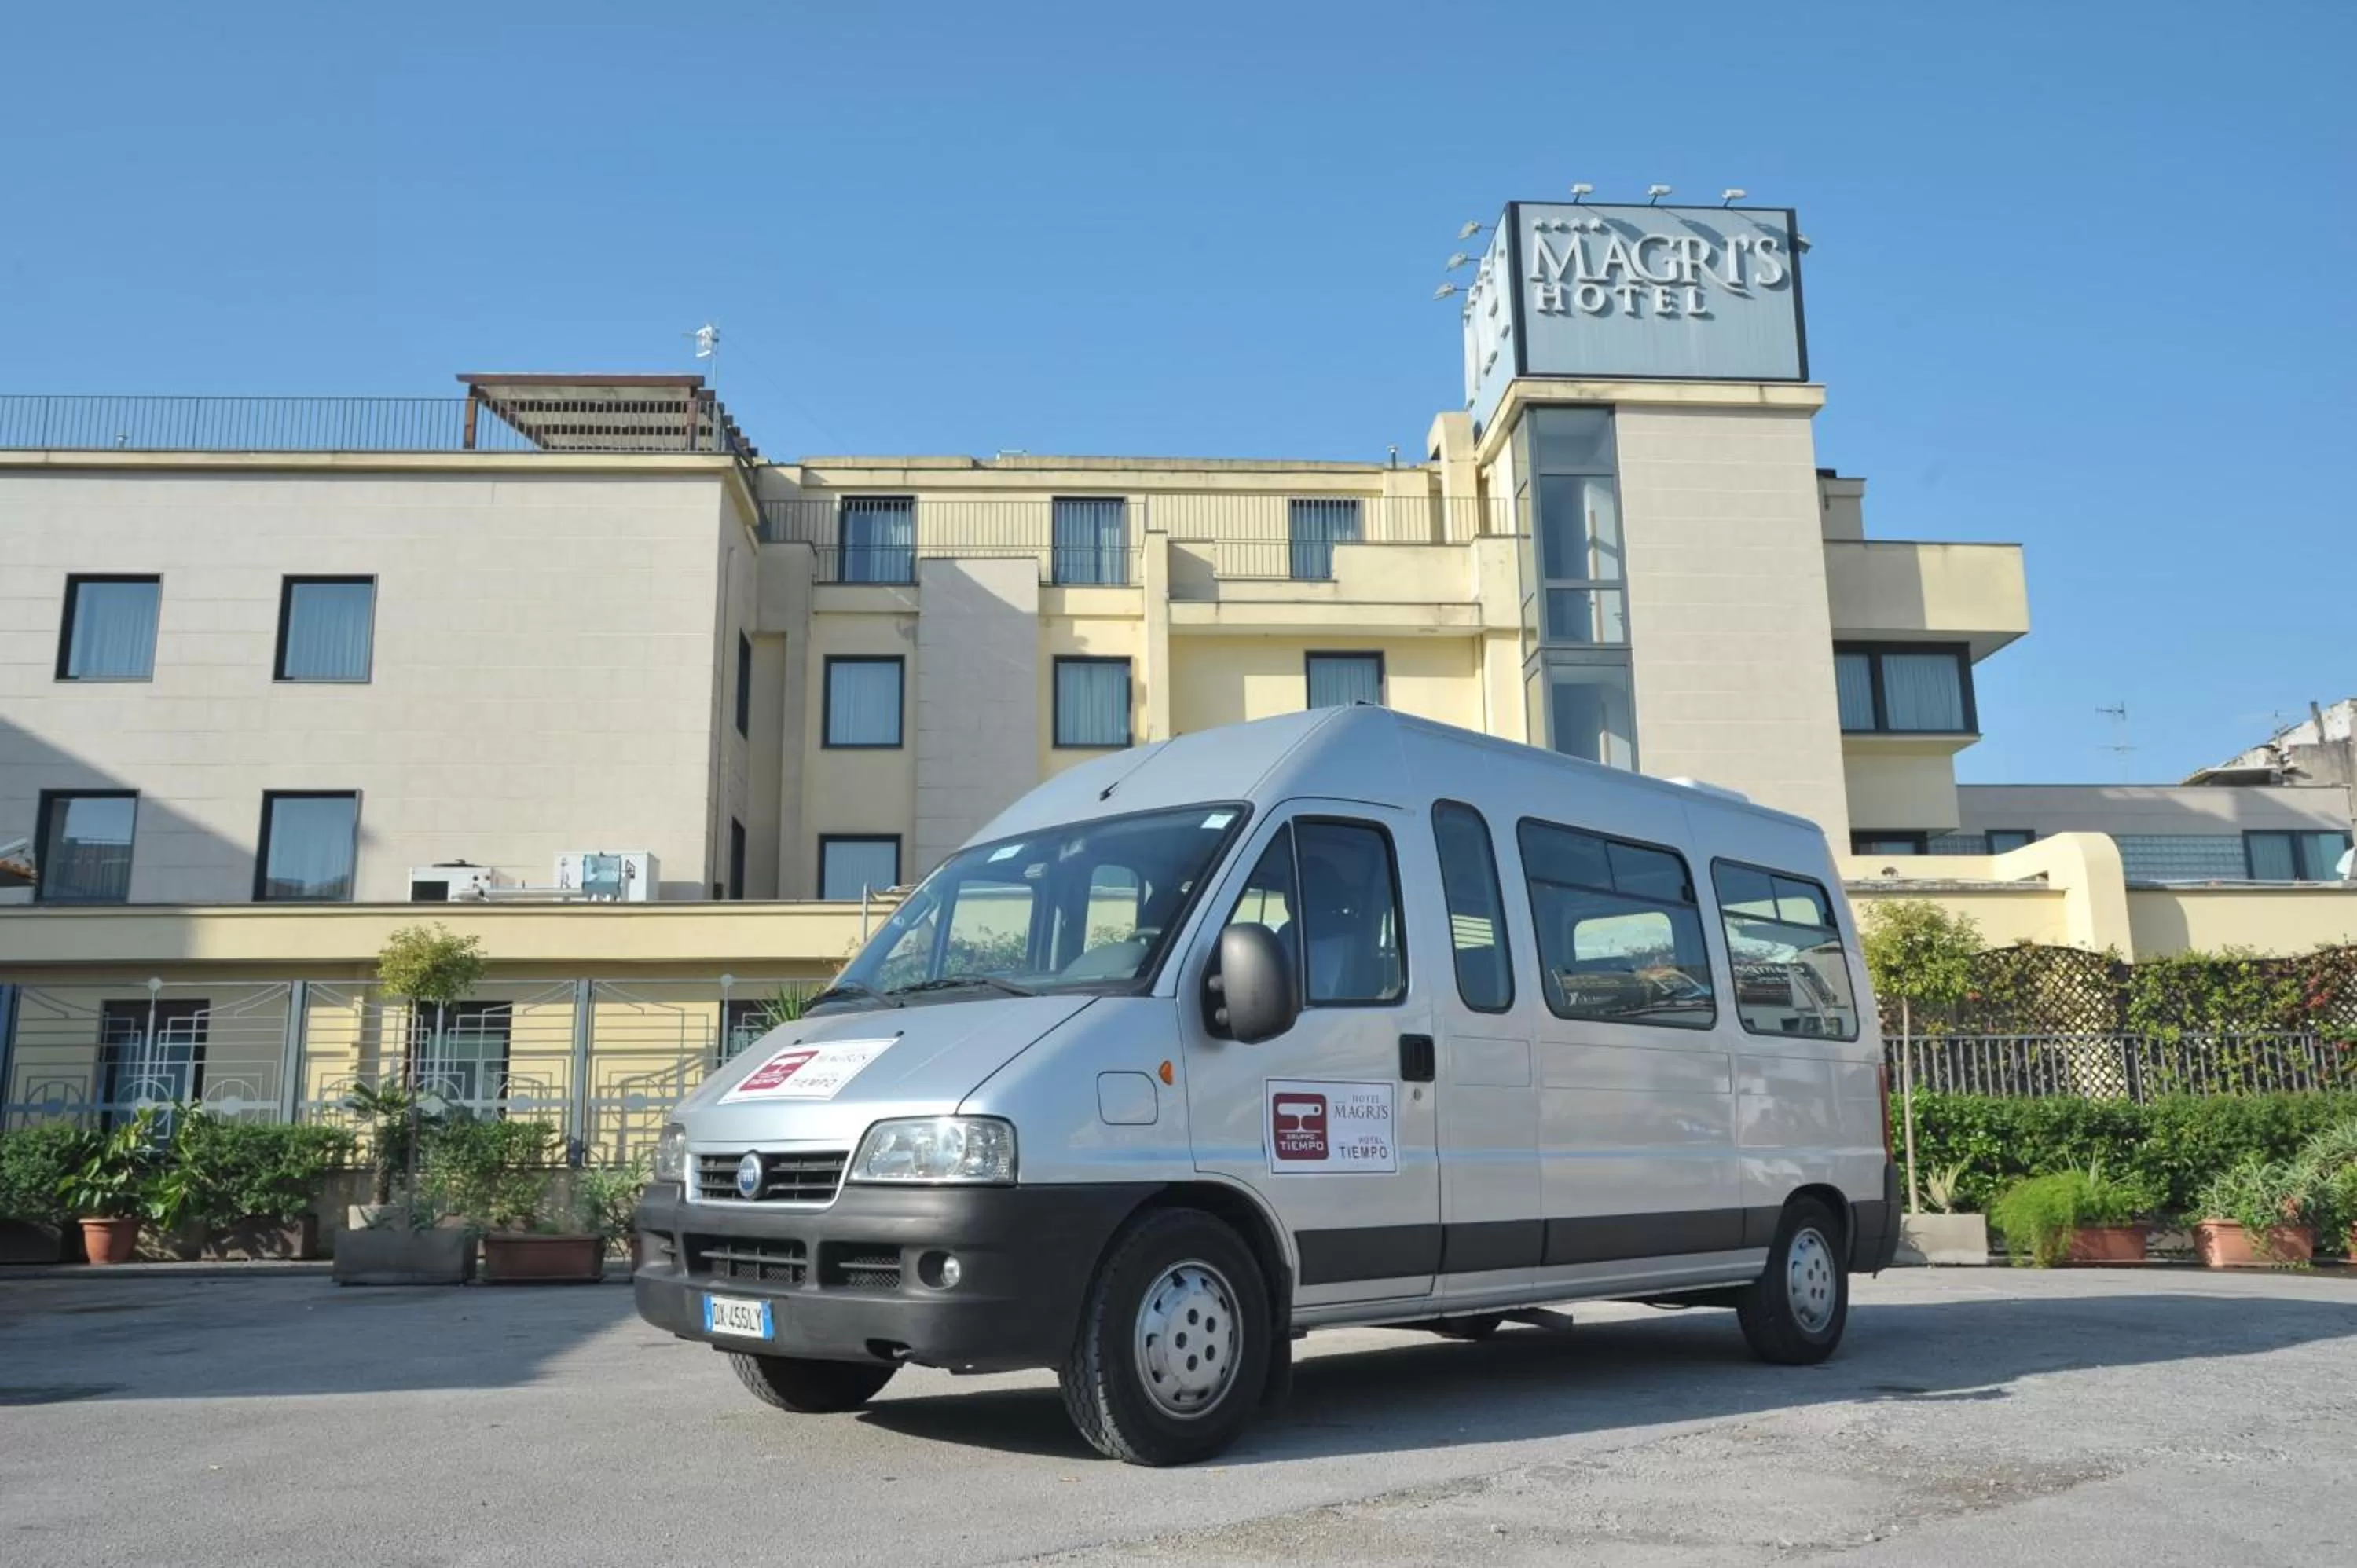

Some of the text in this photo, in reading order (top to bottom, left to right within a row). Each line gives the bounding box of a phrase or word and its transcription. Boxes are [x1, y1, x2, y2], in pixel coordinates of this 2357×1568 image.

[1530, 230, 1783, 296] MAGRI'S
[1532, 282, 1708, 315] HOTEL
[1352, 1094, 1380, 1103] HOTEL
[1279, 1141, 1324, 1151] TIEMPO
[1338, 1145, 1388, 1159] TIEMPO
